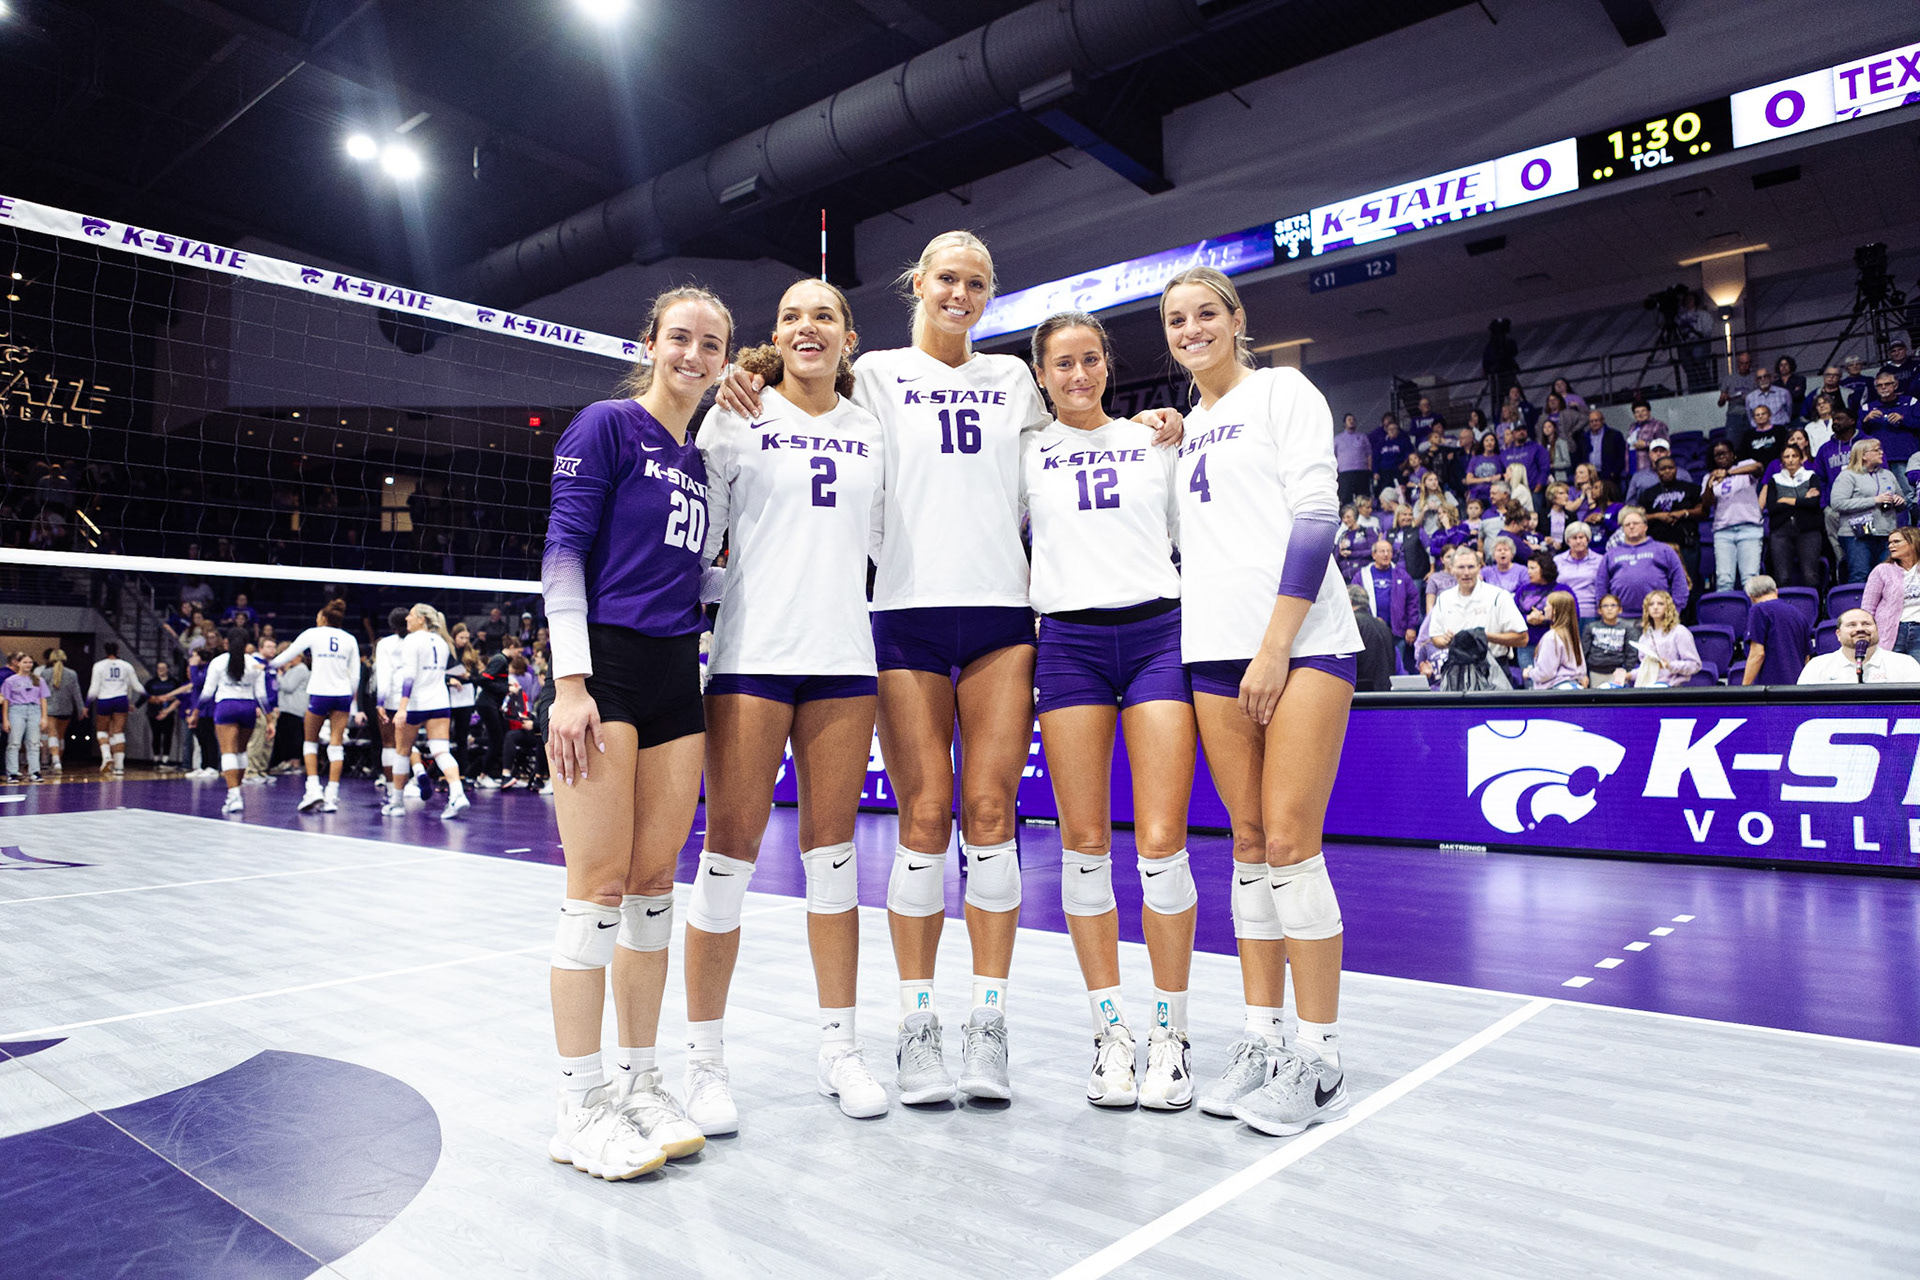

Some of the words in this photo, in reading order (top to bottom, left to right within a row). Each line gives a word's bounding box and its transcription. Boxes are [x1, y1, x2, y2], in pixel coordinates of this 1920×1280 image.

[1608, 111, 1701, 160] 1:30
[1630, 147, 1674, 171] TOL
[1321, 171, 1481, 237] K-STATE
[1275, 213, 1310, 234] SETS
[121, 226, 248, 270] K-STATE
[1274, 226, 1311, 247] WON
[1287, 241, 1300, 258] 3
[1323, 271, 1336, 286] 11
[1366, 261, 1383, 277] 12
[332, 274, 434, 311] K-STATE
[503, 314, 587, 346] K-STATE
[904, 389, 1007, 406] K-STATE
[938, 409, 981, 454] 16
[761, 433, 869, 458] K-STATE
[1043, 448, 1147, 470] K-STATE
[809, 456, 837, 508] 2
[1075, 467, 1120, 511] 12
[1189, 453, 1211, 503] 4
[664, 489, 706, 553] 20
[330, 636, 339, 652] 6
[432, 645, 438, 664] 1
[109, 667, 120, 679] 10
[1439, 843, 1487, 852] DAKTRONICS
